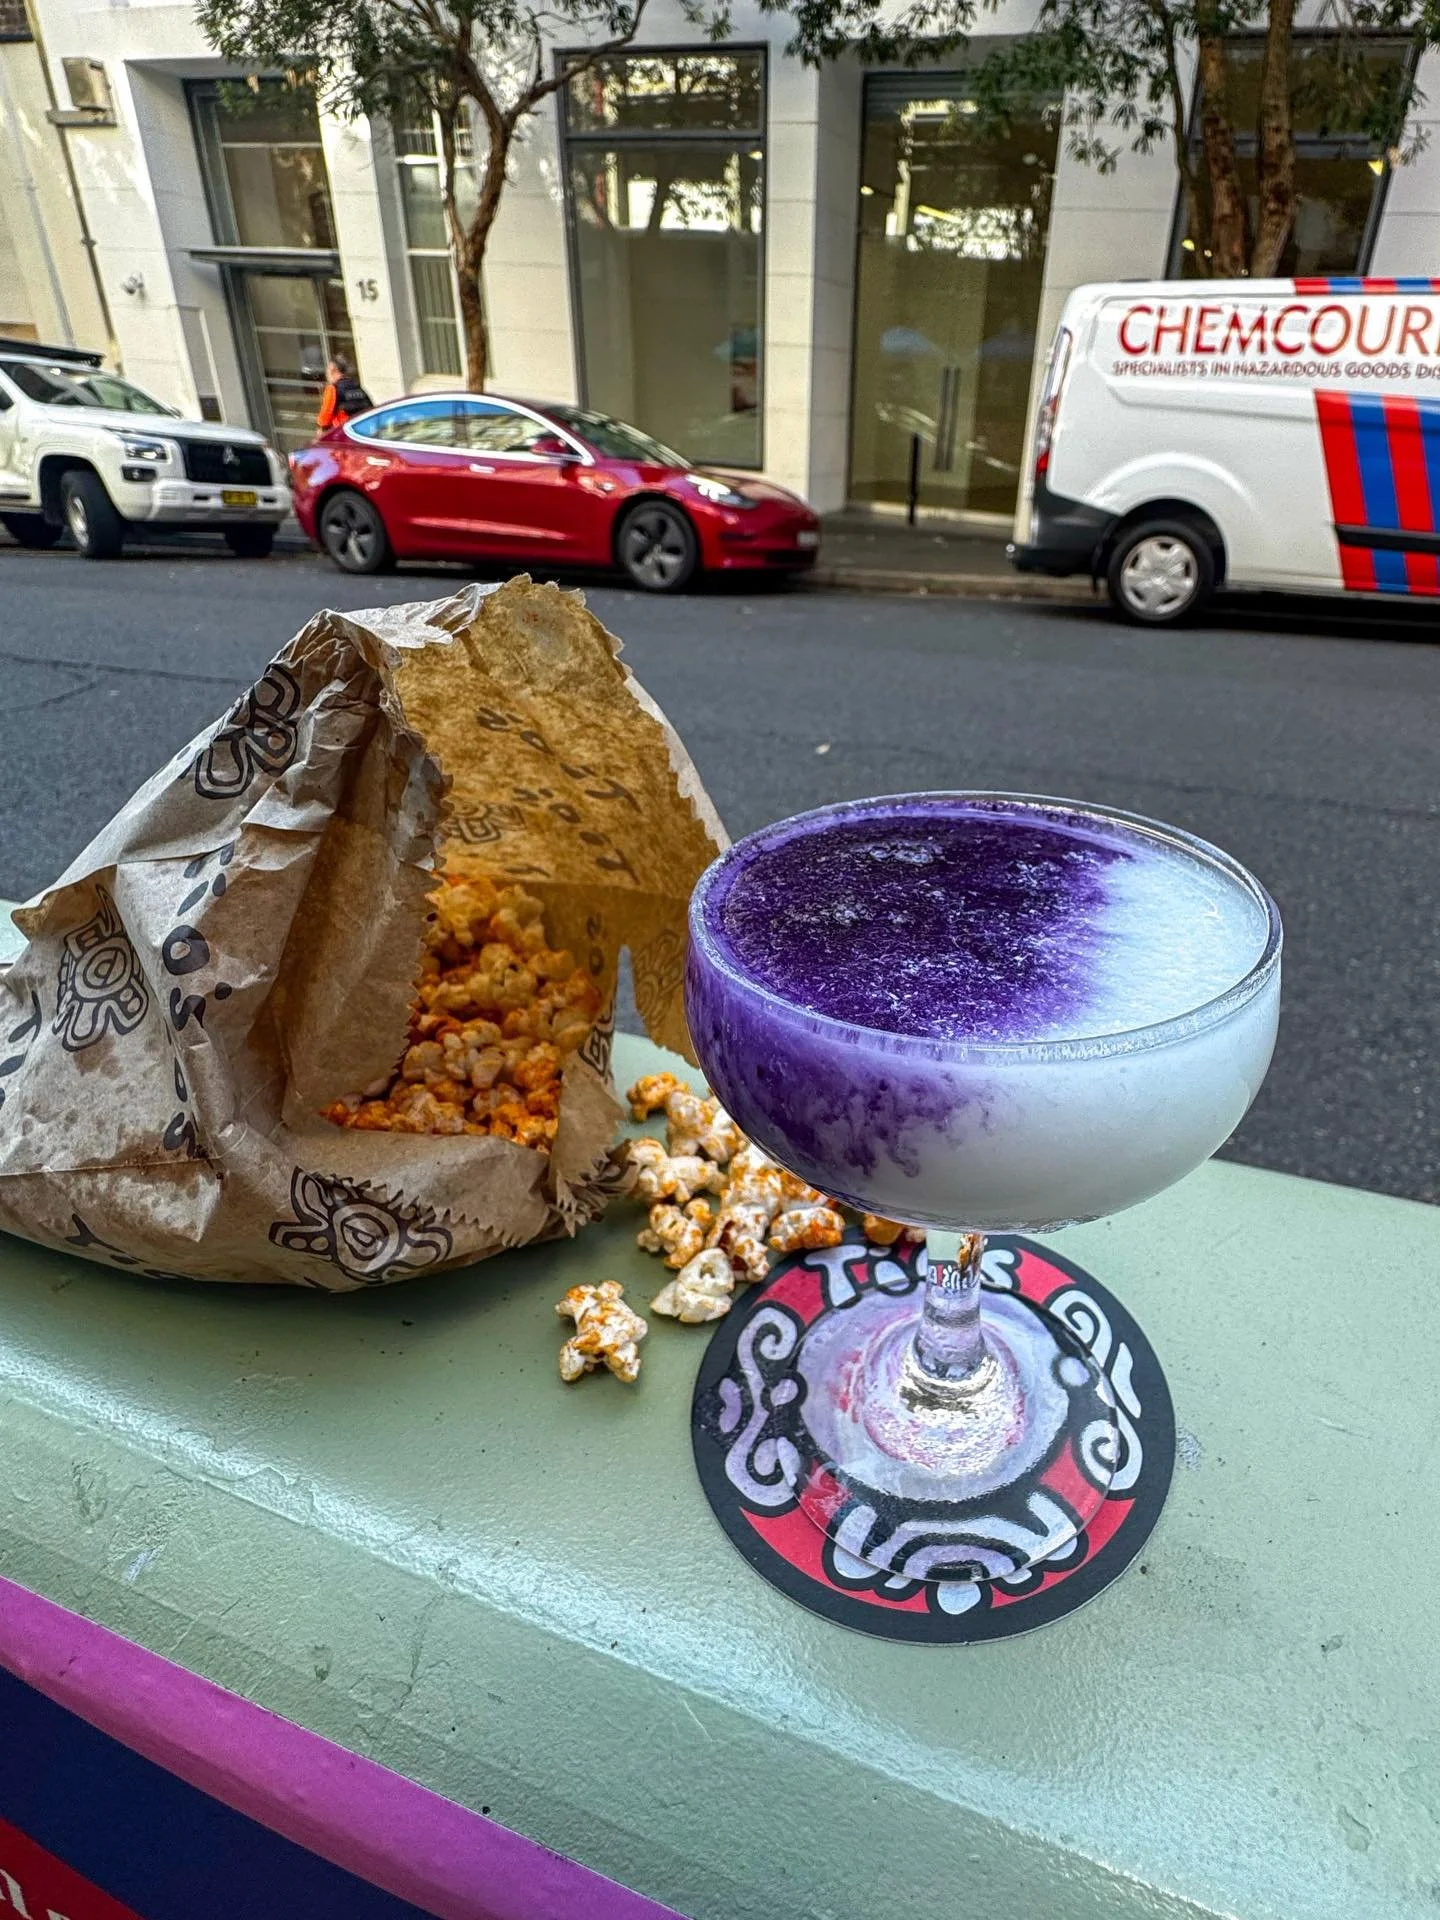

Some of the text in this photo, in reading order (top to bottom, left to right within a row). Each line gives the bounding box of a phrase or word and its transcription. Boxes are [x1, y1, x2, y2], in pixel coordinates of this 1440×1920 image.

[357, 278, 379, 302] 15
[1112, 360, 1207, 376] SPECIALISTS
[1211, 361, 1230, 376] IN
[1233, 361, 1341, 377] HAZARDOUS
[1345, 362, 1411, 378] GOODS
